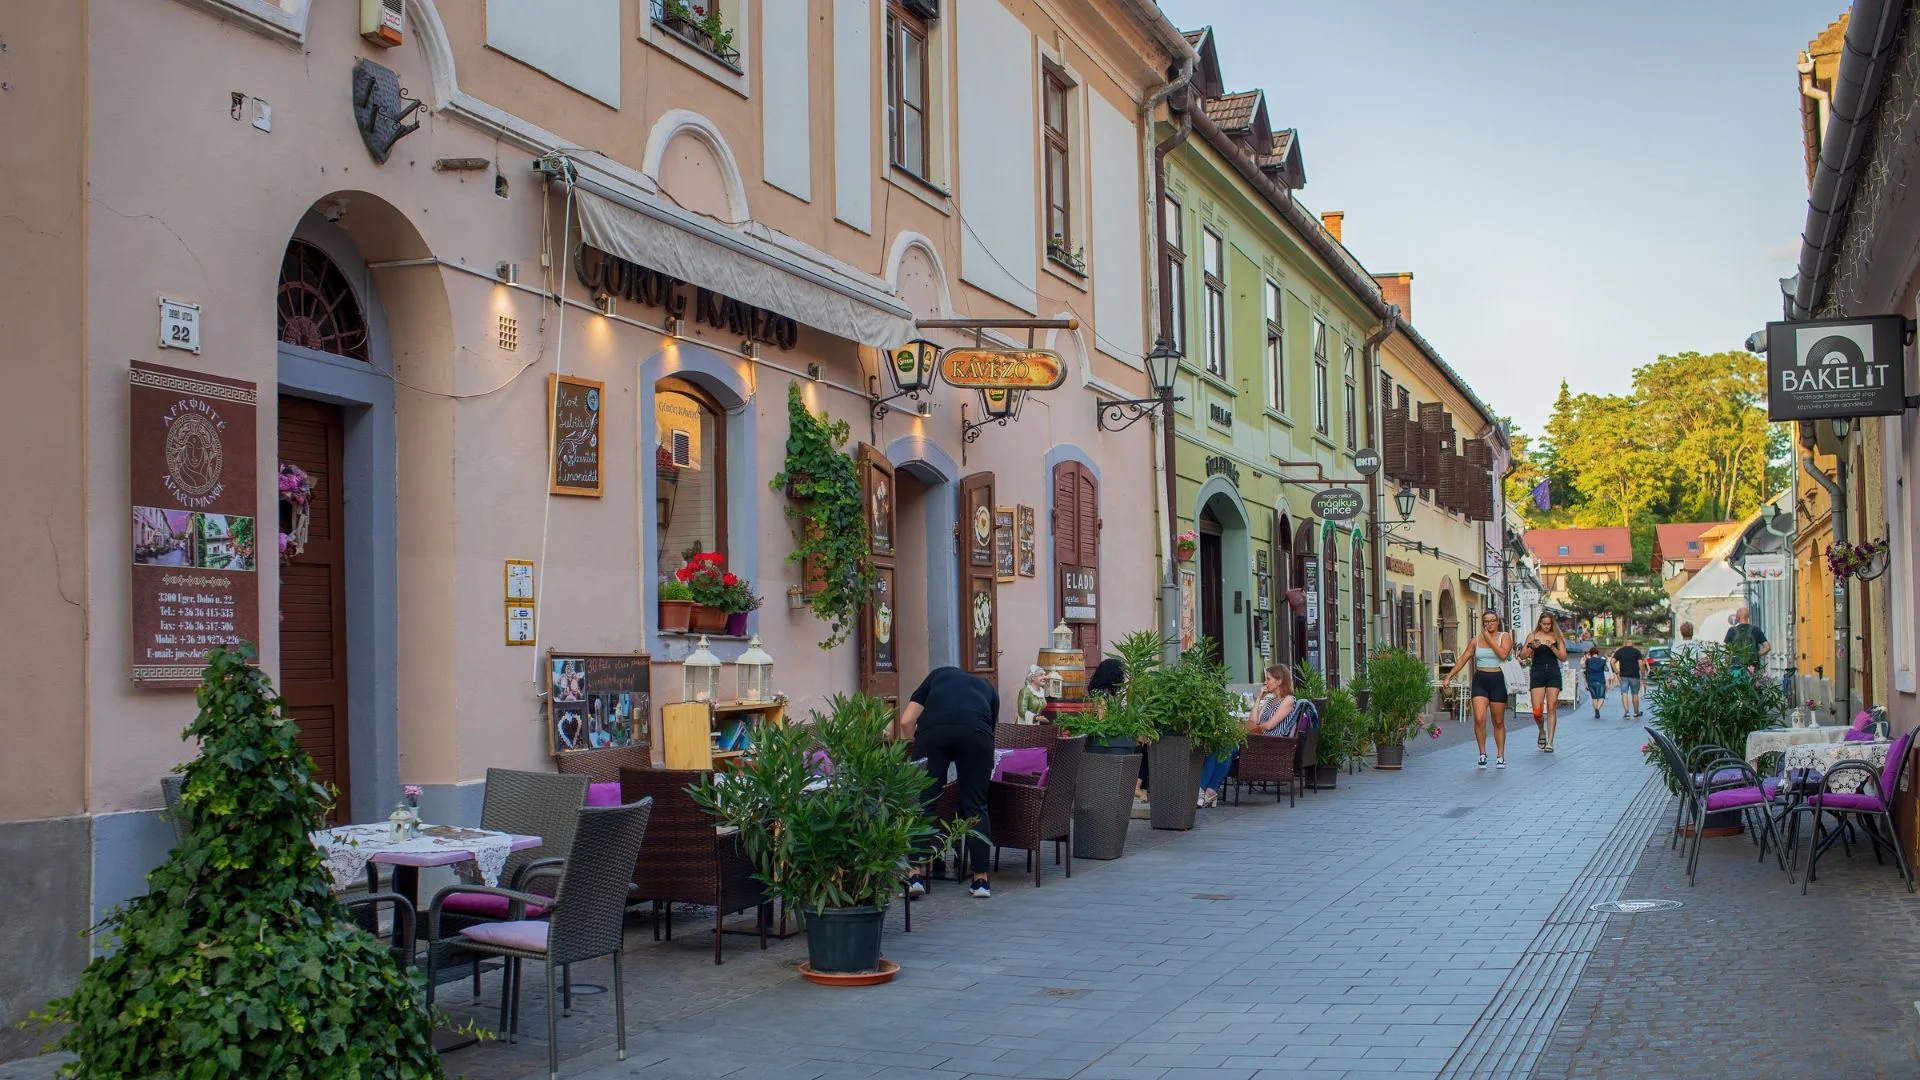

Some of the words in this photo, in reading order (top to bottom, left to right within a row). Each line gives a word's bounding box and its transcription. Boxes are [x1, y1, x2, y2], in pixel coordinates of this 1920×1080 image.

[172, 324, 190, 343] 22
[1782, 365, 1889, 392] BAKELIT
[163, 397, 227, 433] AFRODITE
[1318, 499, 1357, 508] mágikus
[1323, 506, 1352, 517] pince
[1066, 571, 1094, 590] ELADÓ
[158, 592, 177, 603] 3300
[178, 607, 194, 617] +36
[195, 608, 204, 617] 36
[160, 620, 175, 631] Fax:
[178, 621, 194, 631] +36
[195, 621, 204, 631] 36
[180, 635, 195, 645] +36
